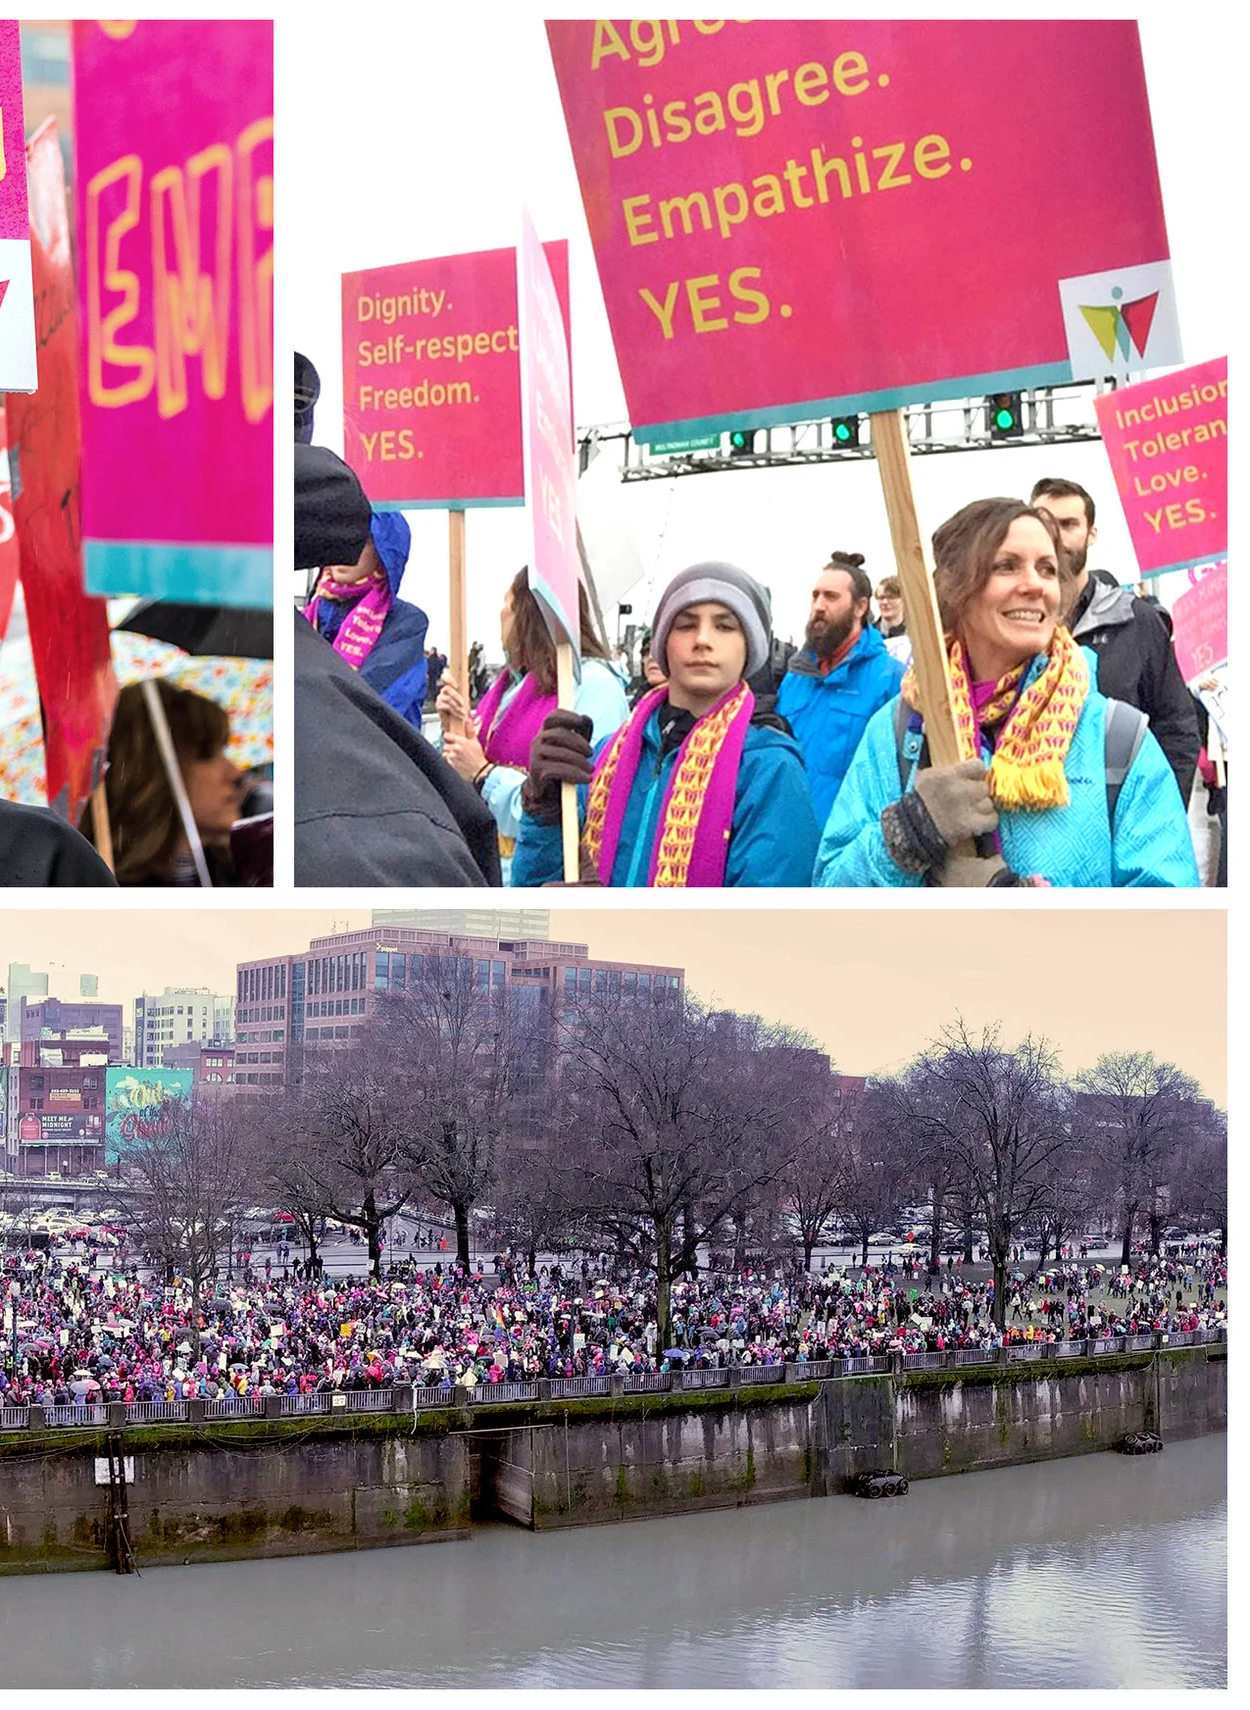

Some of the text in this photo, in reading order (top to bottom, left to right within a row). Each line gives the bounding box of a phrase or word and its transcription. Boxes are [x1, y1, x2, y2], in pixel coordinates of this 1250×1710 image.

[591, 19, 754, 70] Agr
[604, 49, 891, 159] Disagree.
[622, 133, 973, 246] Empathize.
[357, 286, 453, 326] Dignity.
[639, 266, 793, 340] YES.
[358, 325, 519, 367] Self-respect
[359, 379, 480, 411] Freedom.
[359, 429, 424, 462] YES.
[1123, 418, 1228, 462] Toleran
[1134, 464, 1208, 497] Love.
[1143, 498, 1217, 535] YES.
